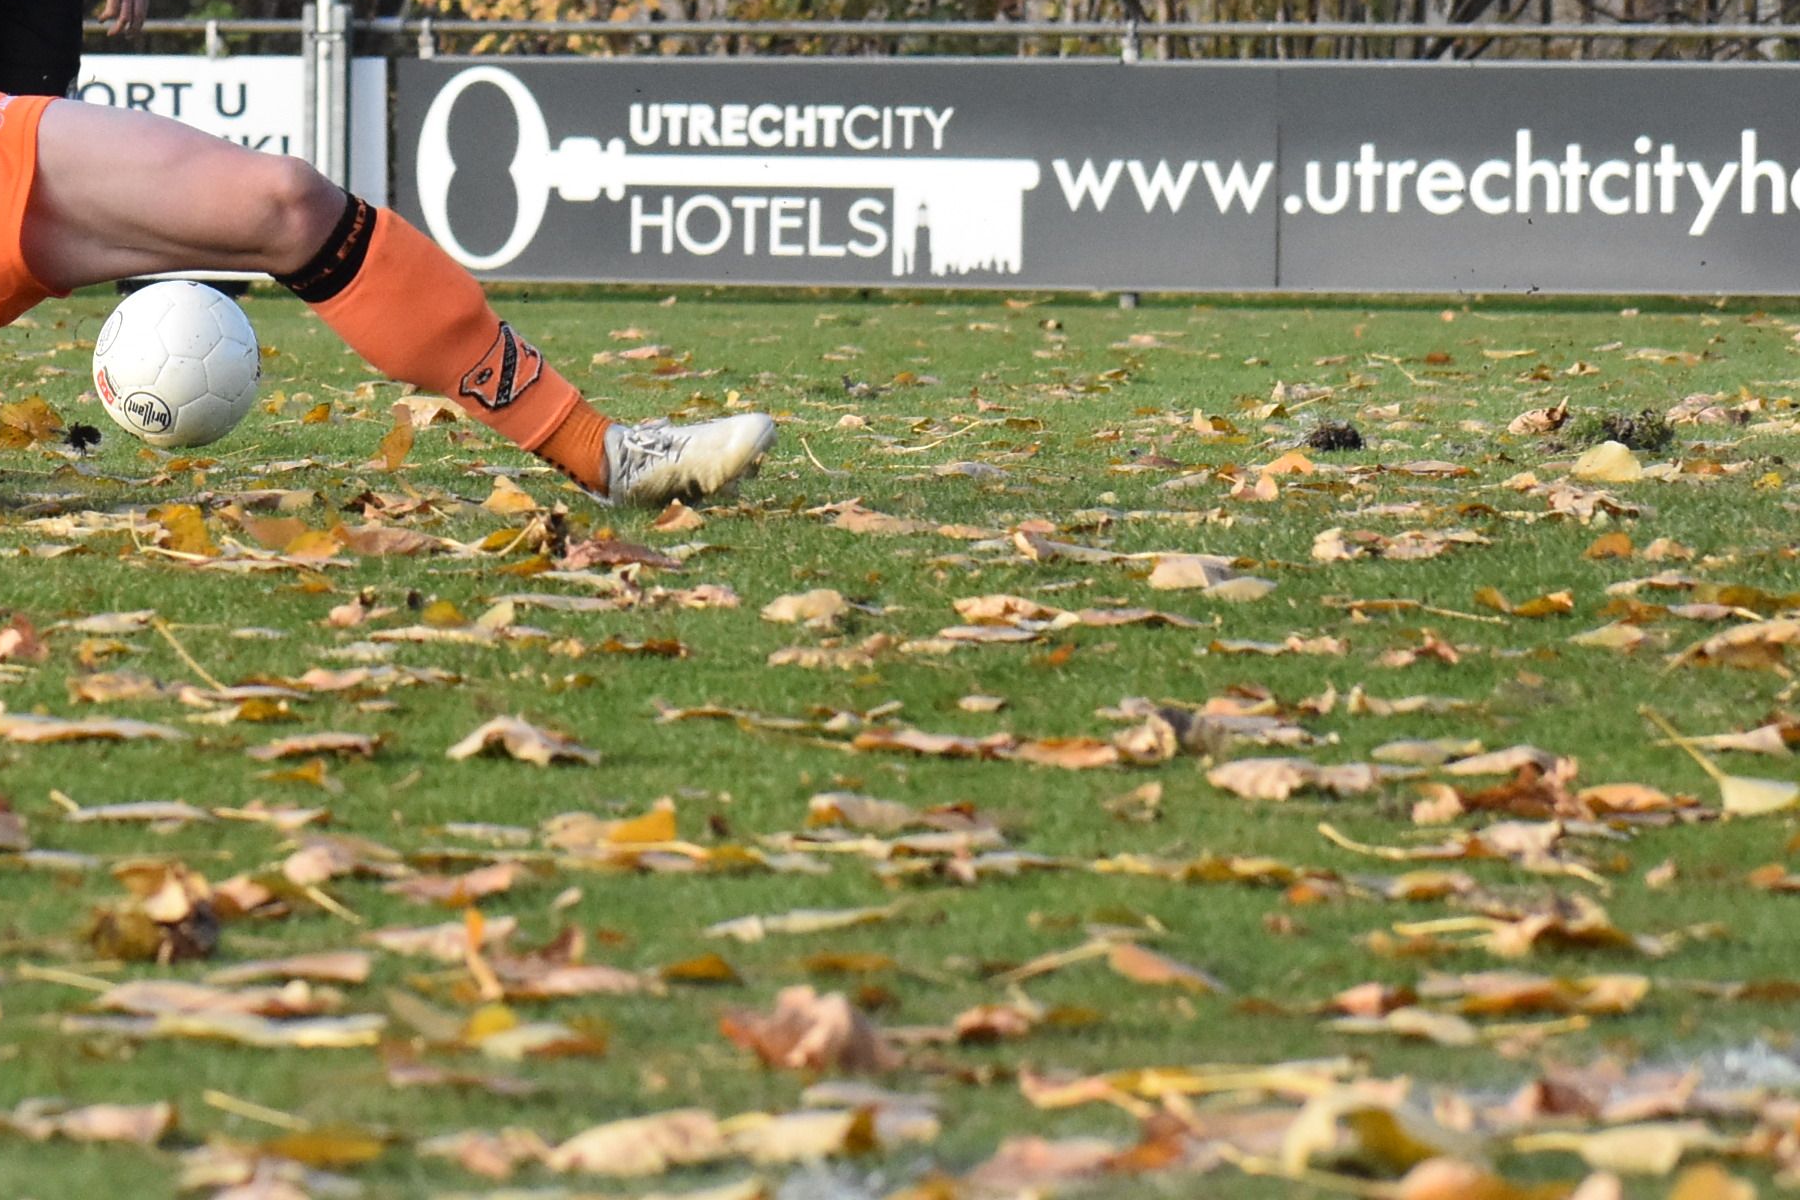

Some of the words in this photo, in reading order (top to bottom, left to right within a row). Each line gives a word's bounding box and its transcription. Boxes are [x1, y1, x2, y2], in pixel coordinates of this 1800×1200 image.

[215, 82, 247, 117] U
[629, 103, 954, 150] UTRECHTCITY
[1051, 128, 1800, 237] www.utrechtcityh
[629, 194, 888, 258] HOTELS
[128, 400, 168, 428] brillant
